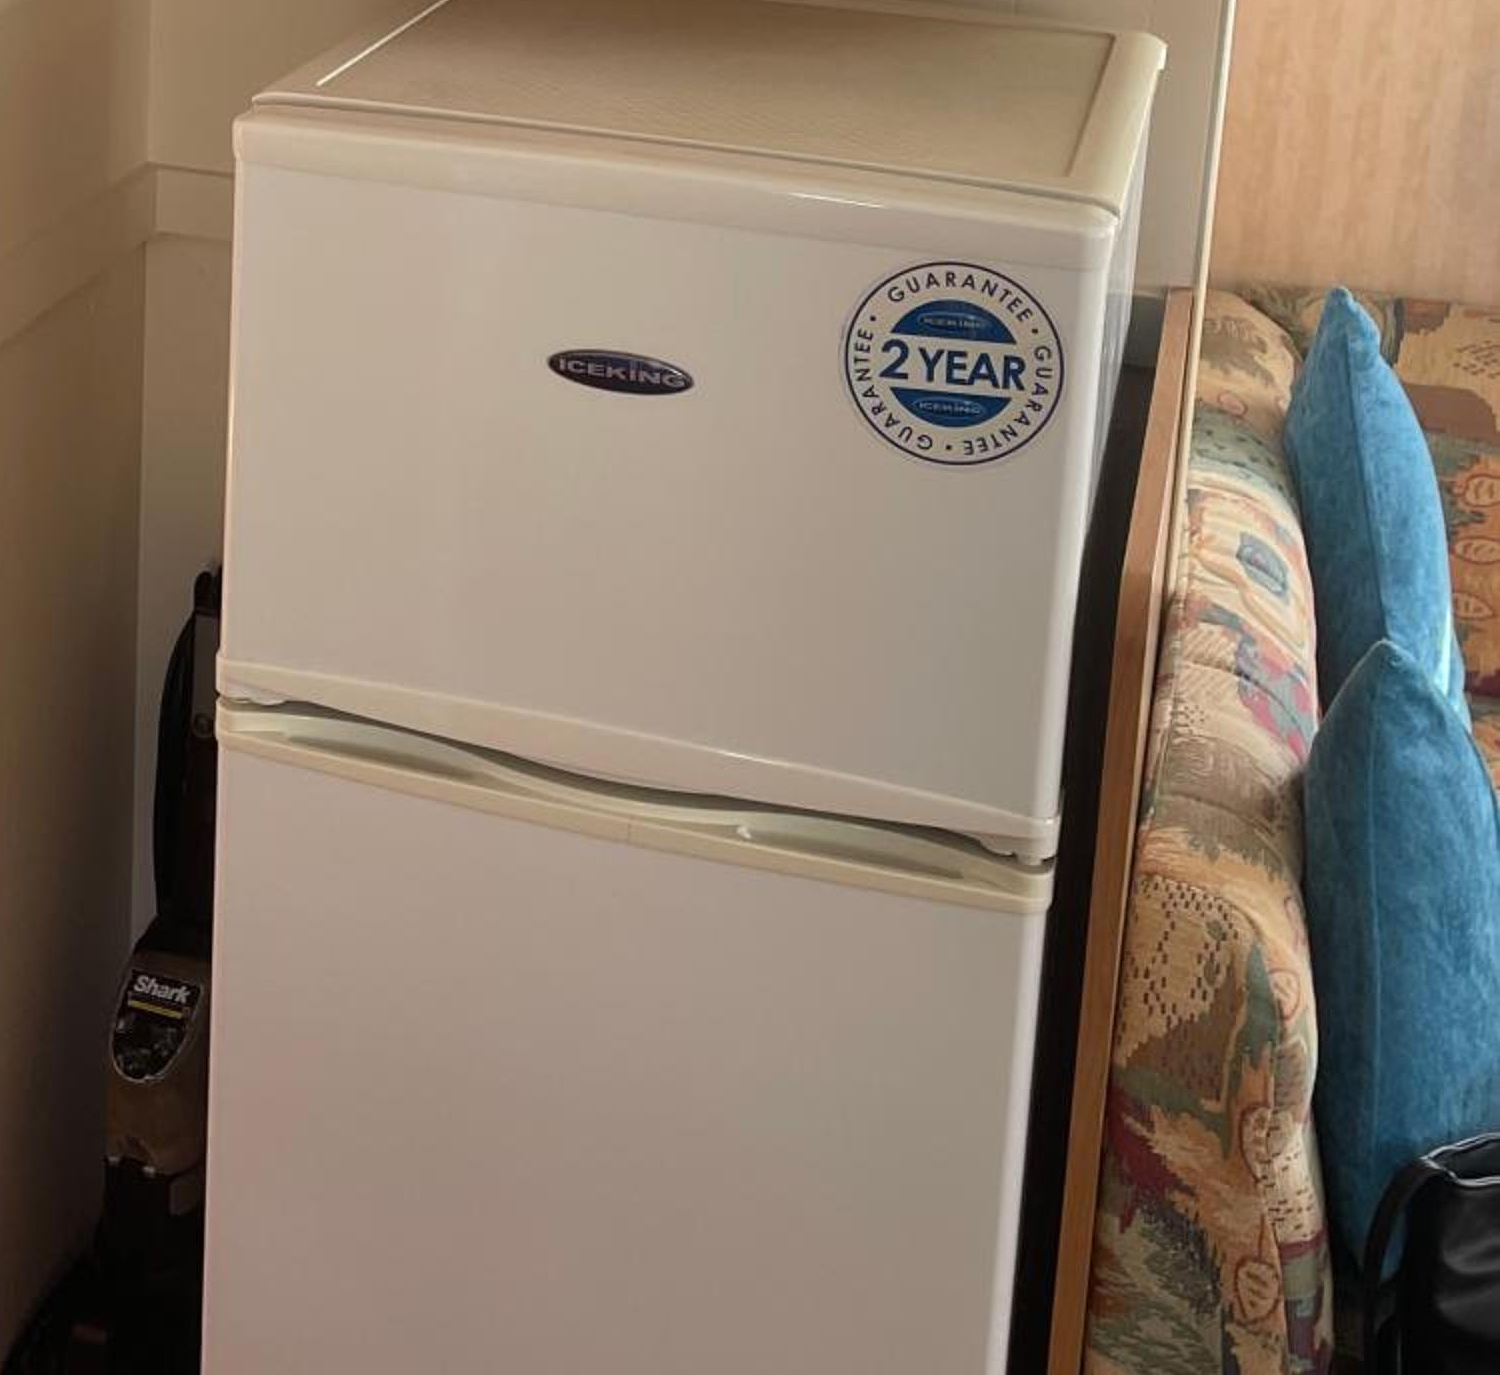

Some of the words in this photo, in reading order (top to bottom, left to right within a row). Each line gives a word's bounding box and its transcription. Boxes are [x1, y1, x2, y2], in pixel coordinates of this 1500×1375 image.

[887, 272, 1032, 323] GUARANTEE
[558, 356, 687, 388] ICEKING
[854, 327, 934, 450] GUARANTEE
[879, 338, 909, 380] 2
[918, 346, 1026, 391] YEAR
[963, 345, 1053, 456] GUARANTEE
[133, 974, 191, 1004] Shark
